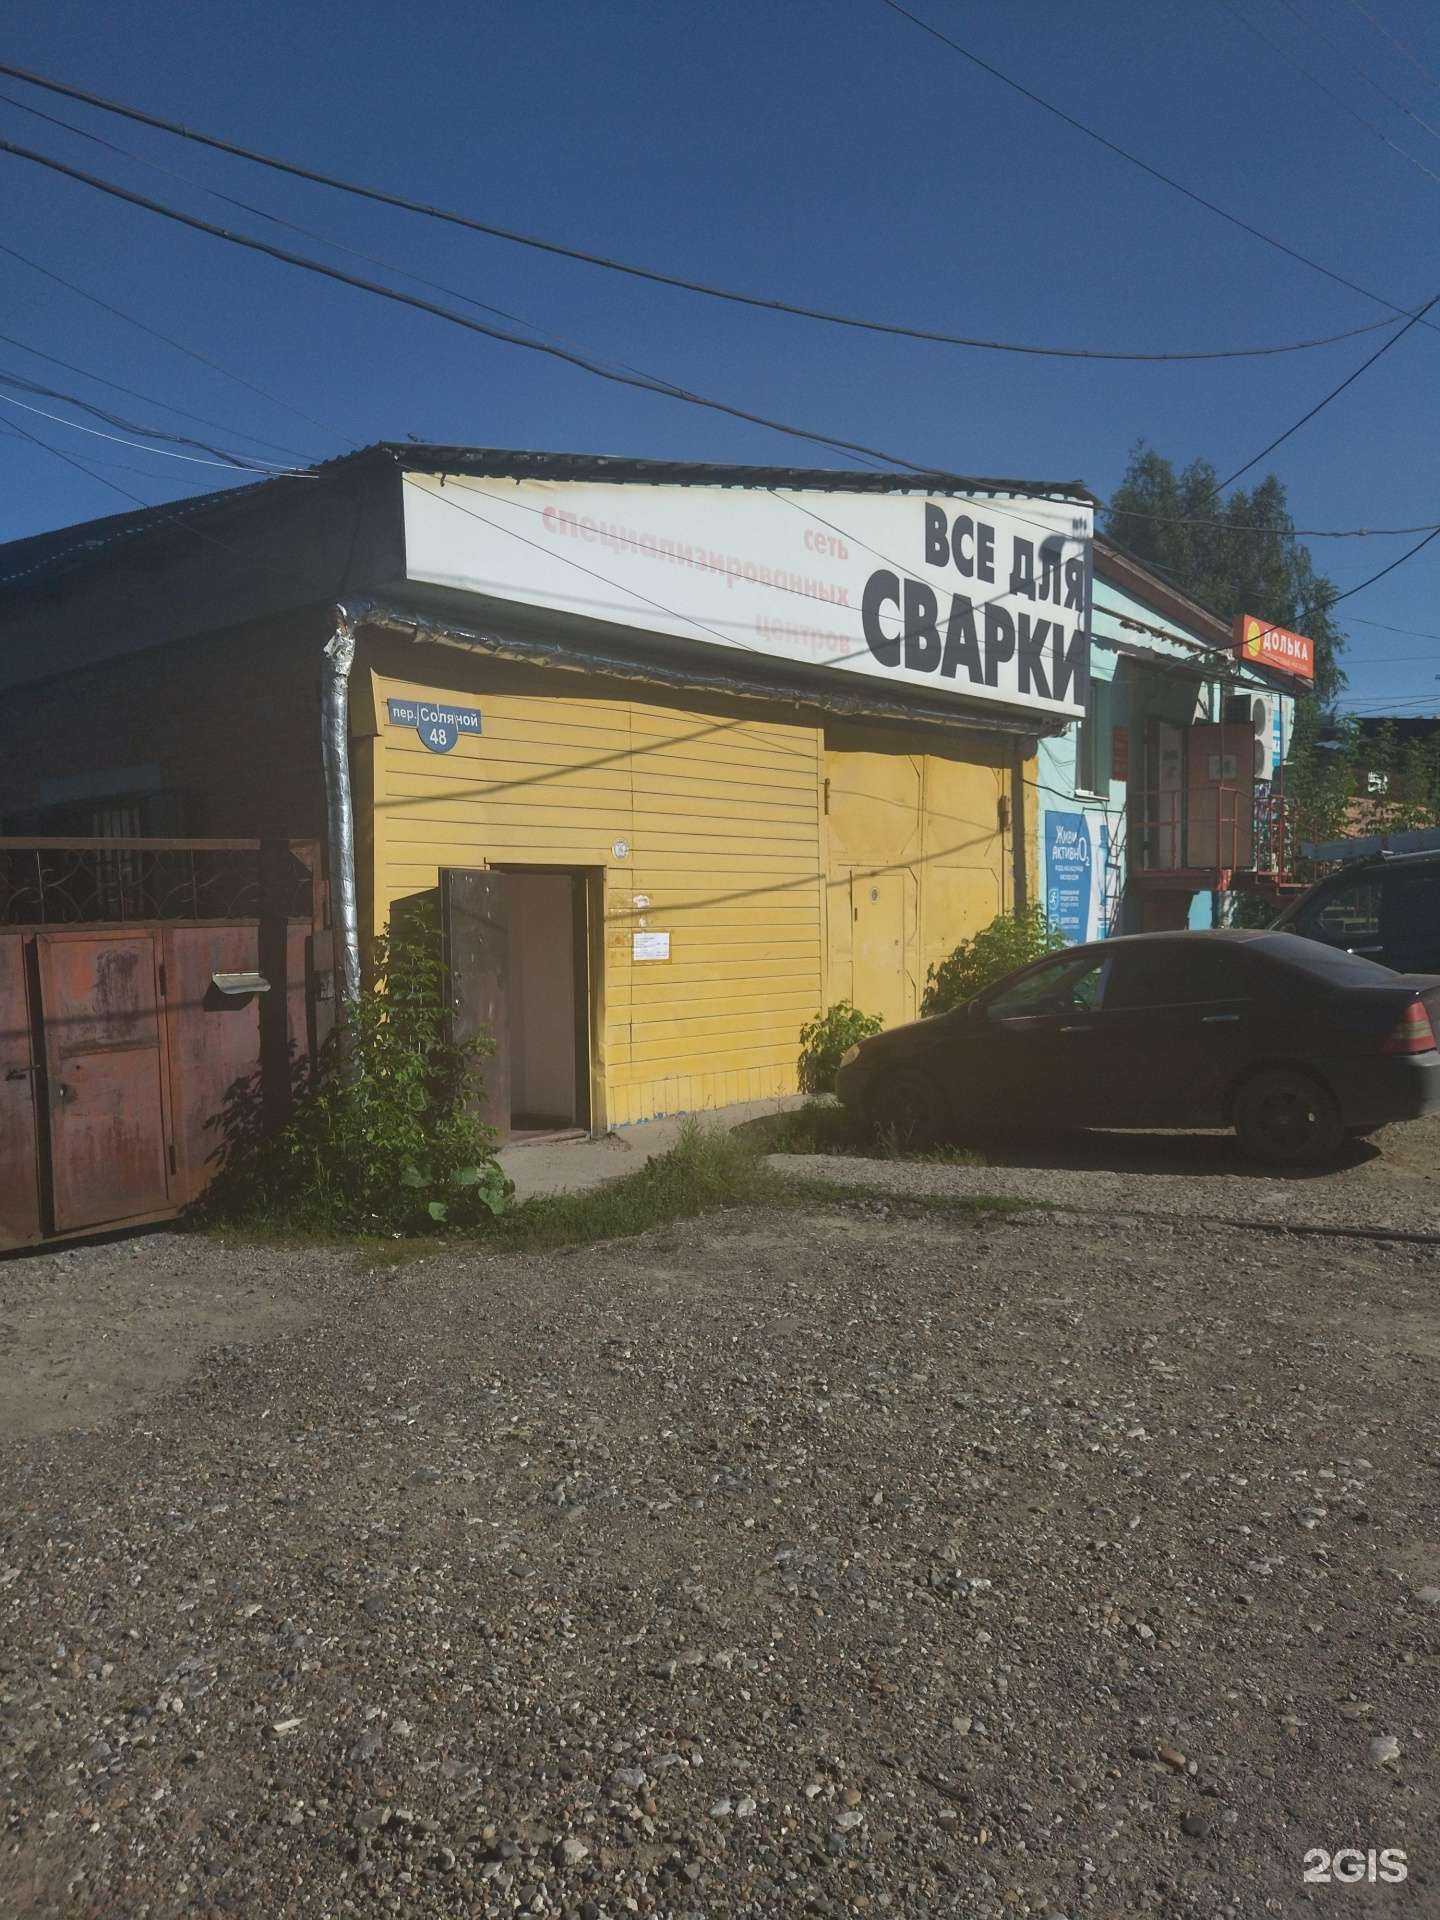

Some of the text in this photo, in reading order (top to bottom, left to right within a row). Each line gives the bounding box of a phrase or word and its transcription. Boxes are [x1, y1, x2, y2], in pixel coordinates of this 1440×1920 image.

[803, 528, 849, 560] сеть
[925, 502, 1084, 613] ВСЕ ДЛЯ
[862, 569, 1085, 706] СВАРКИ
[1262, 630, 1309, 661] ДОЛЬКА
[392, 707, 478, 727] пер. Соляной
[429, 728, 447, 745] 48
